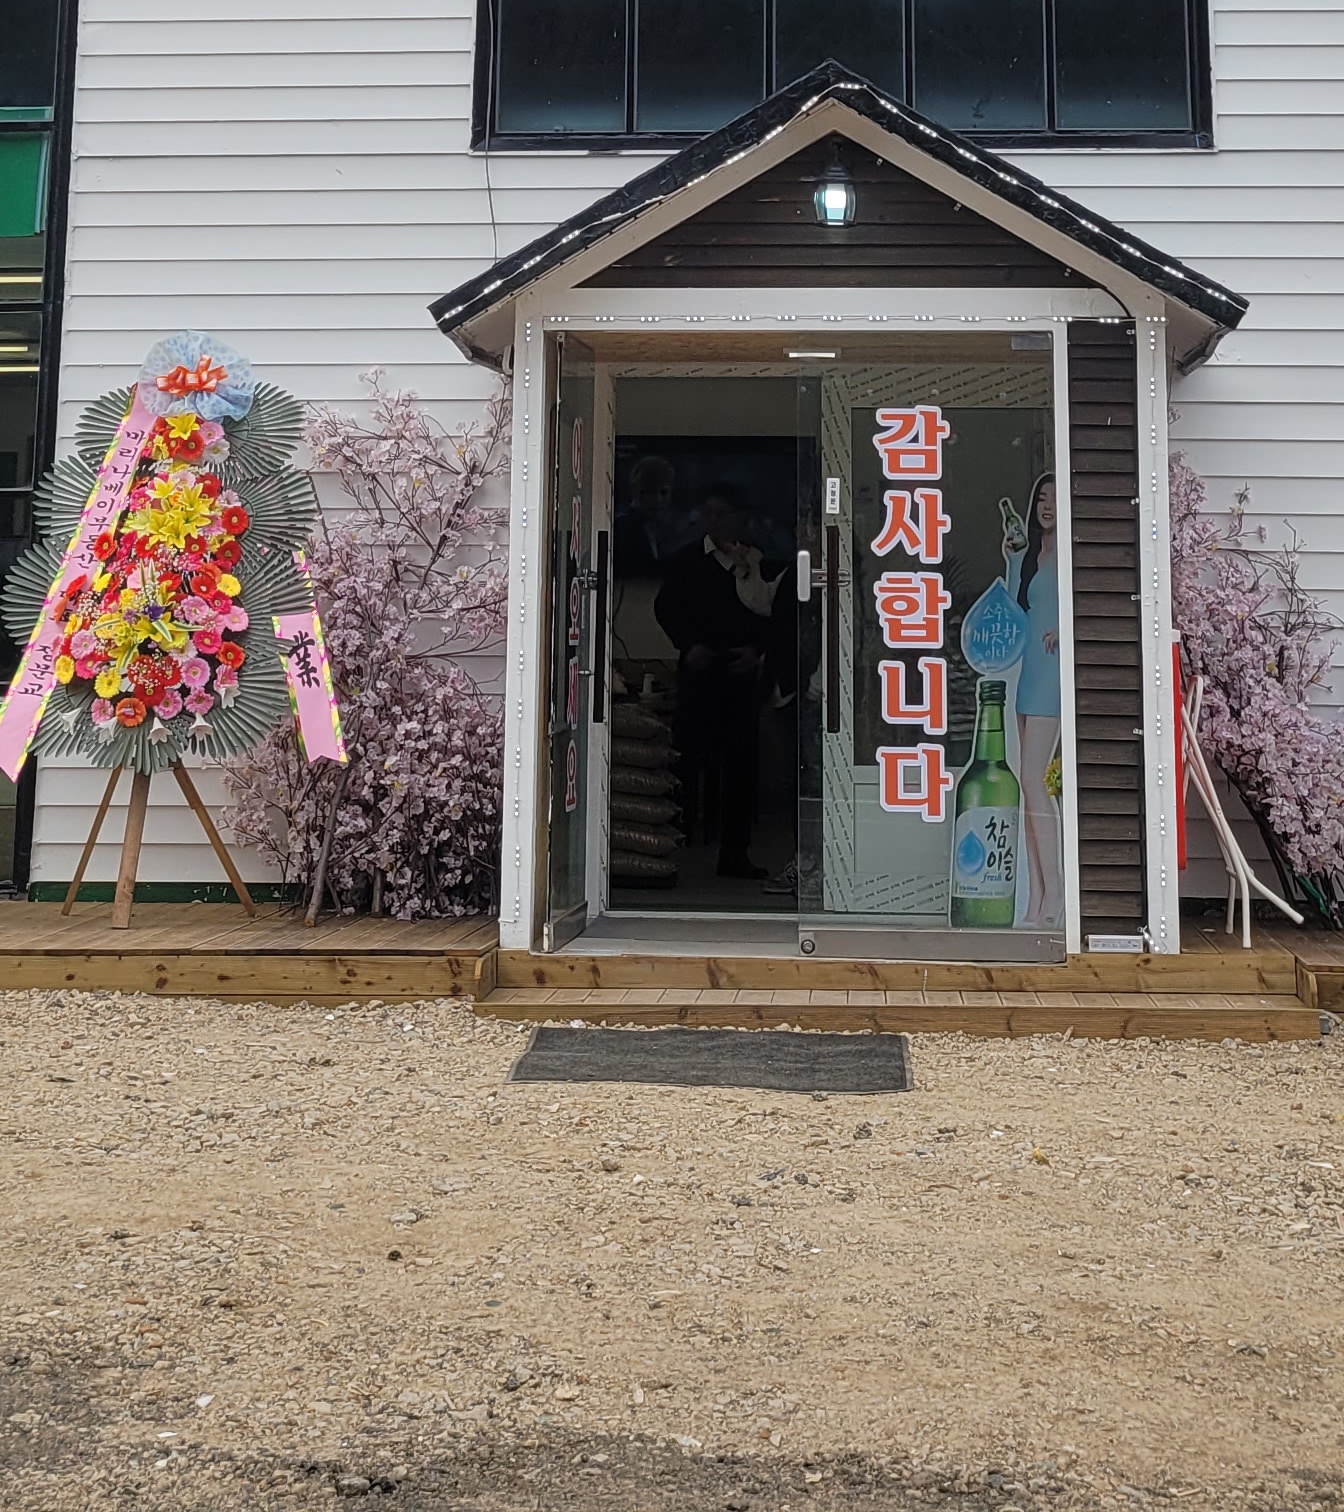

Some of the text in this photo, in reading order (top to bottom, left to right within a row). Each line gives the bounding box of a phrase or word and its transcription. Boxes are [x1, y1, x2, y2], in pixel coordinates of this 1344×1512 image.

[874, 406, 952, 821] 감사합니다
[982, 604, 1011, 621] 소주는
[973, 622, 1021, 646] 깨끗함
[984, 815, 1014, 882] 참이슬
[980, 872, 1002, 884] fresh
